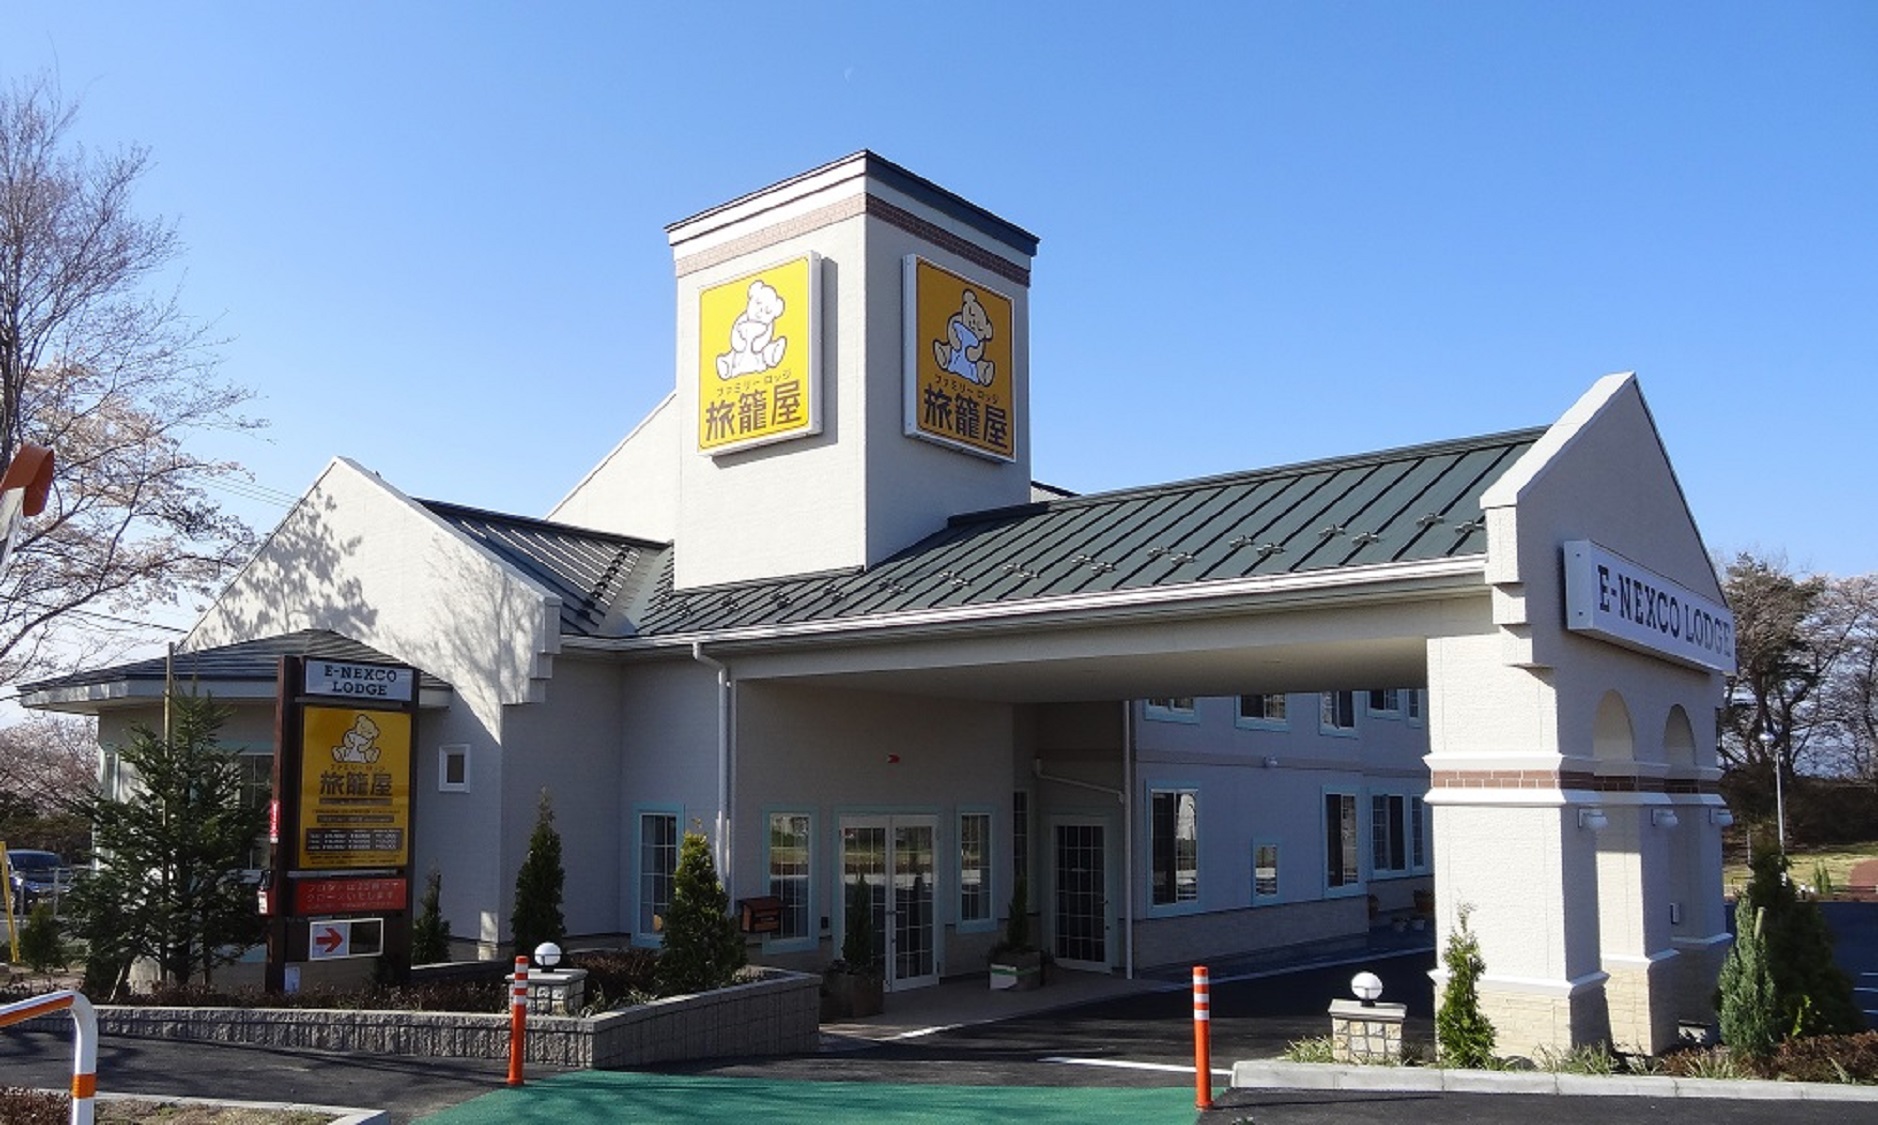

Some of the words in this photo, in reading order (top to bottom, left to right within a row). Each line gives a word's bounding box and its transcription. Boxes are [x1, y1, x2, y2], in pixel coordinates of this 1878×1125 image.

[705, 380, 802, 441] 旅籠屋
[924, 383, 1008, 449] 旅籠屋
[1597, 564, 1681, 639] E-NEXCO
[1685, 602, 1732, 658] LODGE
[324, 664, 397, 683] E-NEXCO
[331, 681, 388, 696] LODGE
[320, 770, 393, 796] 旅籠屋
